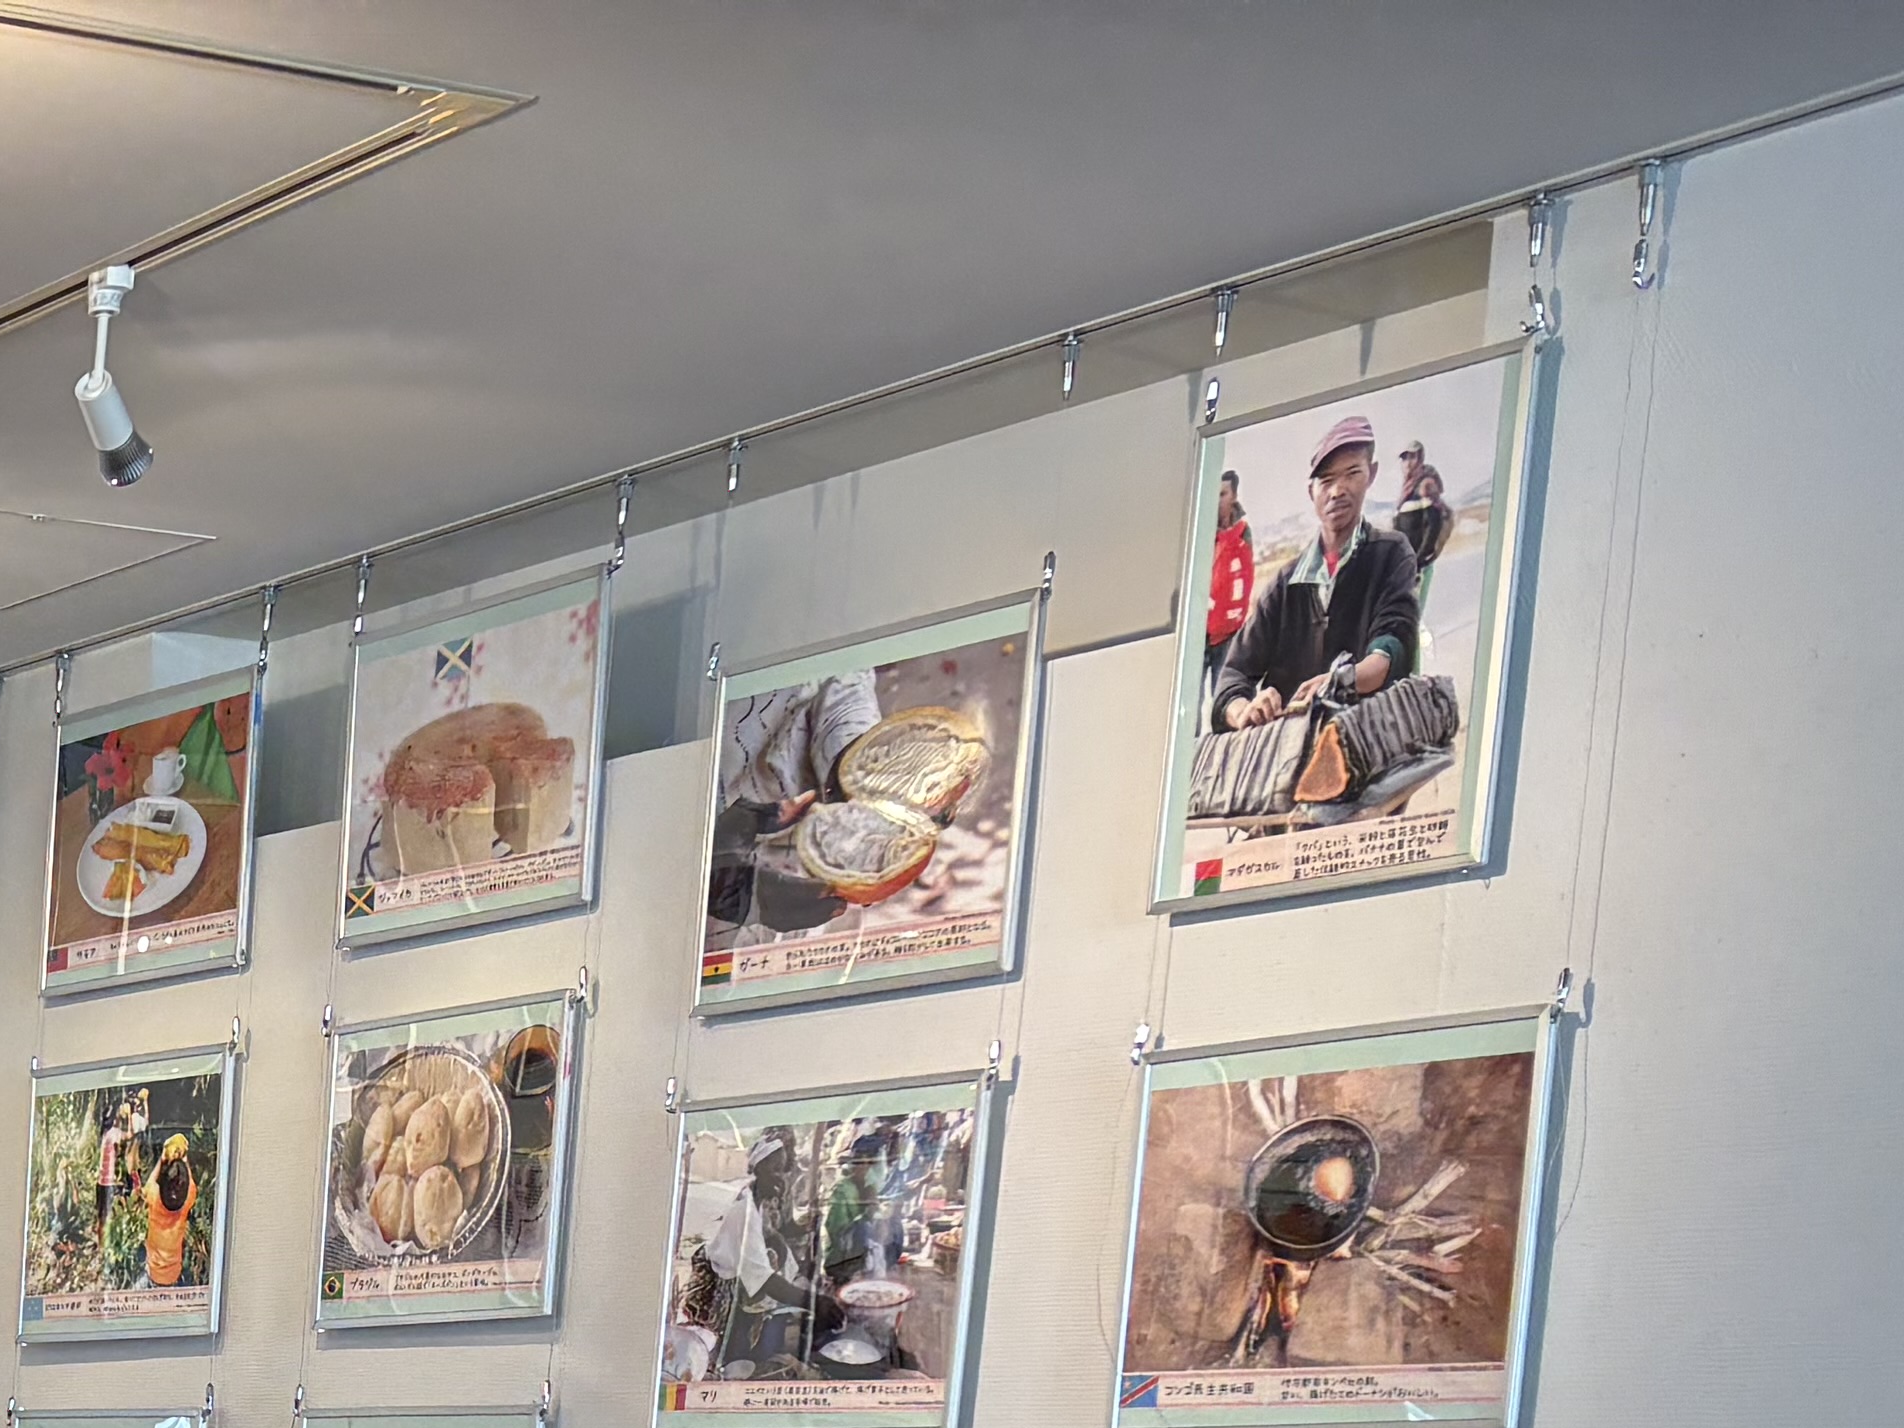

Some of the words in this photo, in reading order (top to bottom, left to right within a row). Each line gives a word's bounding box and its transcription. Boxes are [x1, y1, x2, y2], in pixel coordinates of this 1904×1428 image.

[1226, 861, 1282, 878] マダガスカル
[700, 1390, 718, 1403] マリ
